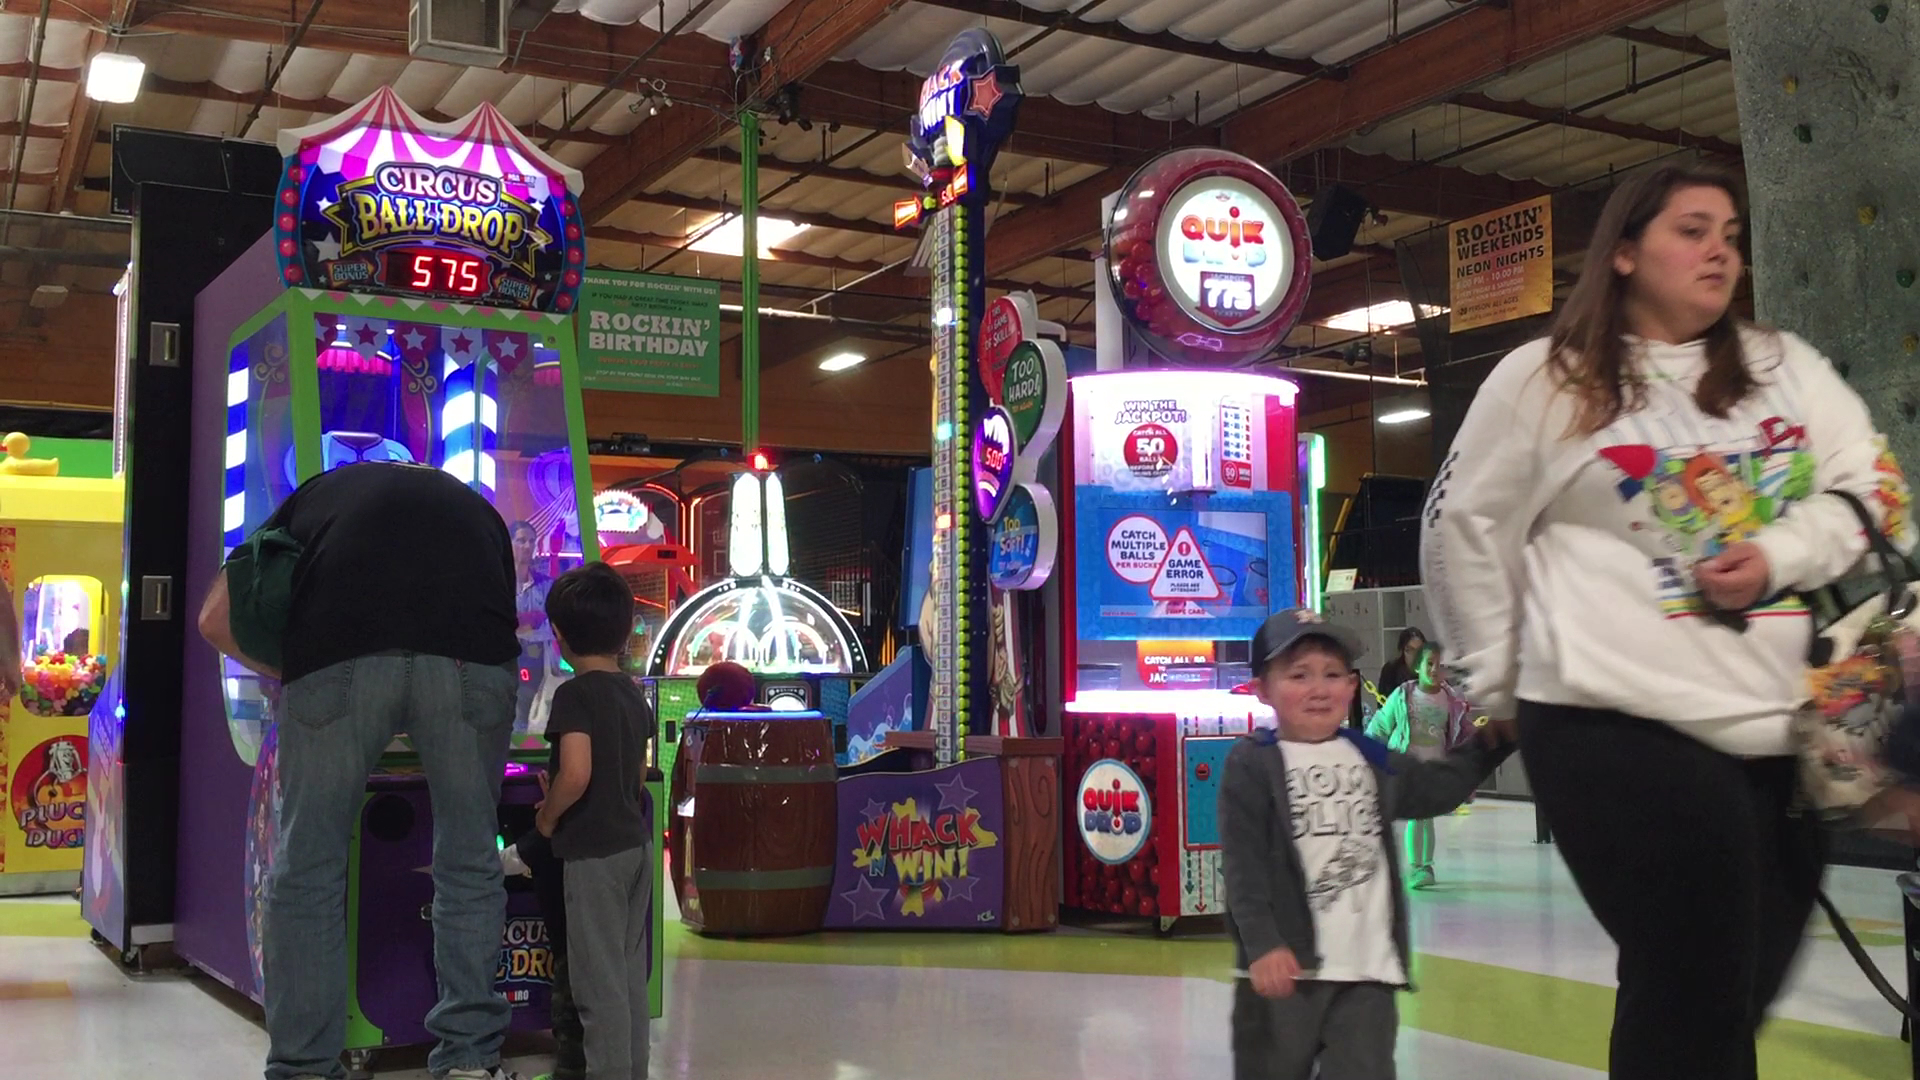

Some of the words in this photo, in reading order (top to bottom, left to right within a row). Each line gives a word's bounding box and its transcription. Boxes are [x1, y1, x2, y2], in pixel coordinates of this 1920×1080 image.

[378, 165, 497, 205] CIRCUS
[353, 193, 435, 240] BALL
[440, 201, 523, 254] DROP
[1455, 205, 1543, 247] ROCKIN'
[1456, 224, 1545, 261] WEEKENDS
[333, 263, 368, 273] SUPER
[412, 255, 480, 293] 575
[1456, 258, 1492, 279] NEON
[1495, 245, 1545, 268] NIGHTS
[333, 271, 370, 282] BONUS
[583, 276, 610, 286] THANK
[612, 279, 629, 287] YOU
[630, 280, 646, 288] FOR
[647, 282, 682, 291] ROCKIN'
[683, 285, 703, 294] WITH
[703, 287, 717, 295] US!
[590, 310, 711, 338] ROCKIN'
[588, 332, 710, 358] BIRTHDAY
[1011, 357, 1034, 383] TOO
[1008, 373, 1040, 402] HARD!
[1114, 409, 1188, 425] JACKPOT!
[1123, 399, 1152, 412] WIN
[1152, 399, 1178, 411] THE
[1136, 437, 1165, 455] 50
[1111, 540, 1166, 551] MULTIPLE
[1121, 530, 1156, 540] CATCH
[1120, 551, 1155, 560] BALLS
[1168, 559, 1202, 568] GAME
[1166, 569, 1204, 579] ERROR
[1143, 656, 1172, 665] CATCH
[1173, 656, 1189, 664] ALL
[20, 801, 86, 829] PLUC
[856, 811, 980, 851] WHACK
[868, 854, 887, 877] N
[892, 847, 970, 883] WIN!
[510, 947, 555, 979] DRO
